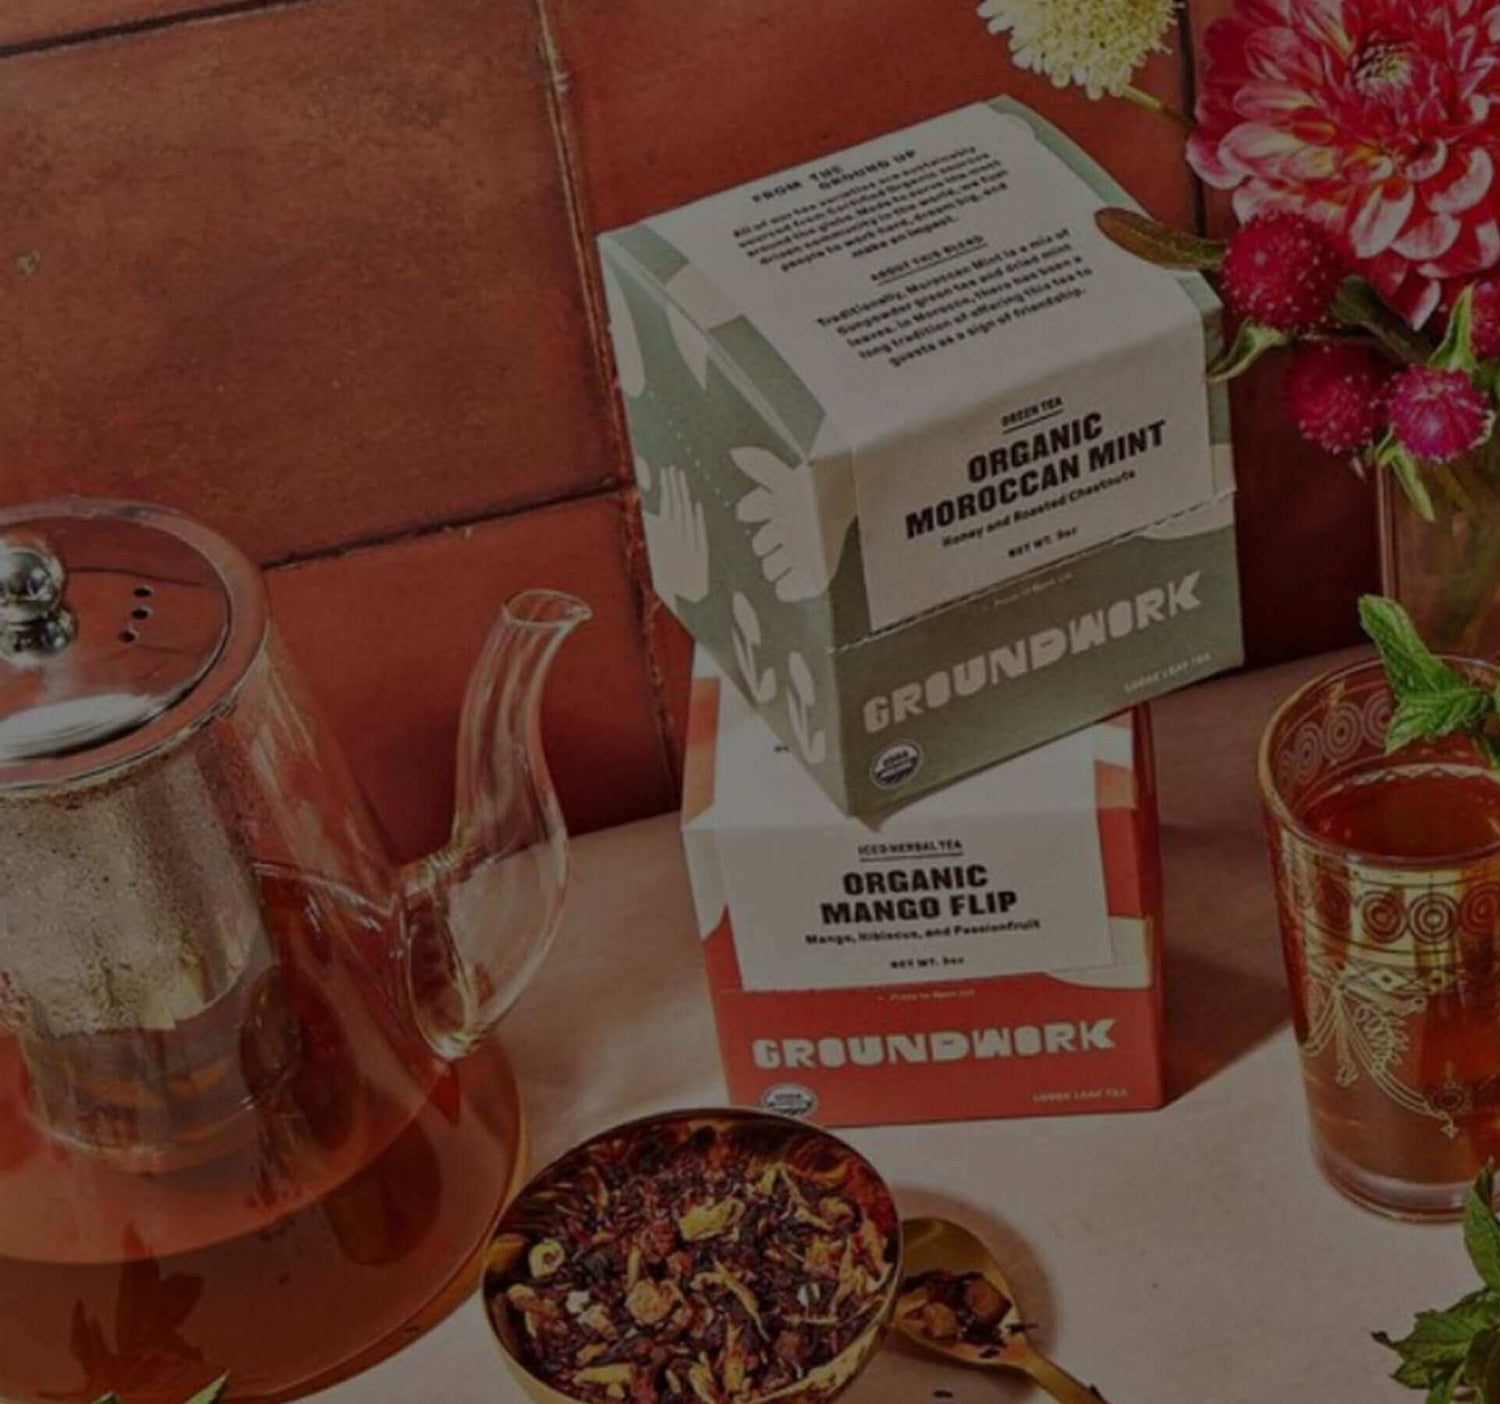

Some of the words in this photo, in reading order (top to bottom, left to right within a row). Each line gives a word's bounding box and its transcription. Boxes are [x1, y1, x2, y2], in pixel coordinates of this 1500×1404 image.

[733, 226, 753, 239] All
[753, 220, 768, 231] of
[769, 212, 793, 225] our
[792, 204, 818, 215] tea
[818, 181, 877, 207] varieties
[878, 173, 901, 185] are
[901, 146, 976, 177] sustainably
[751, 181, 802, 203] FROM
[809, 165, 843, 182] THE
[818, 160, 891, 190] GROUND
[892, 149, 916, 163] UP
[738, 223, 792, 249] sourced
[792, 212, 826, 228] from
[885, 171, 938, 194] Organic
[938, 152, 991, 175] sources
[746, 235, 793, 258] around
[792, 228, 818, 240] the
[855, 200, 892, 216] Made
[891, 194, 908, 203] to
[908, 181, 945, 198] serve
[944, 173, 968, 184] the
[759, 245, 802, 265] driven
[803, 218, 878, 249] community
[877, 212, 893, 222] in
[892, 203, 917, 216] the
[960, 180, 981, 191] we
[780, 250, 826, 273] people
[825, 243, 843, 254] to
[843, 230, 876, 248] work
[913, 202, 957, 222] dream
[982, 182, 1008, 196] and
[852, 240, 888, 258] make
[889, 233, 907, 245] an
[870, 260, 910, 282] ABOUT
[912, 250, 942, 265] THIS
[942, 235, 984, 255] BLEND
[905, 266, 972, 295] Moroccan
[971, 253, 1003, 270] Mint
[1002, 248, 1018, 258] is
[1019, 245, 1028, 253] a
[1029, 235, 1054, 249] mix
[1055, 228, 1070, 240] of
[836, 302, 912, 336] Gunpowder
[913, 288, 953, 309] green
[952, 279, 978, 292] tea
[979, 267, 1004, 284] and
[1005, 254, 1040, 273] dried
[1041, 243, 1072, 260] mint
[973, 281, 1013, 300] there
[1012, 271, 1039, 285] has
[1037, 259, 1072, 277] been
[1073, 255, 1083, 264] a
[858, 343, 893, 359] long
[890, 320, 953, 348] tradition
[953, 311, 968, 324] of
[970, 293, 1025, 318] offering
[1023, 282, 1052, 297] this
[1051, 274, 1076, 286] tea
[1075, 267, 1093, 278] to
[889, 343, 937, 368] guests
[938, 336, 955, 347] as
[955, 332, 966, 341] a
[966, 319, 996, 337] sign
[996, 311, 1012, 325] of
[1001, 405, 1040, 427] GREEN
[1040, 396, 1063, 411] TEA
[967, 412, 1103, 483] ORGANIC
[905, 453, 1080, 540] MOROCCAN
[1088, 419, 1165, 472] MINT
[942, 526, 984, 548] Honey
[986, 515, 1011, 533] and
[1013, 494, 1067, 523] Roasted
[1068, 469, 1136, 503] Chestnuts
[1007, 542, 1031, 558] NET
[864, 570, 1201, 733] GROUNDWORK
[857, 843, 888, 856] ICED
[887, 841, 937, 853] HERBAL
[938, 839, 963, 850] TEA
[843, 864, 988, 896] ORGANIC
[805, 934, 857, 946] Mango,
[858, 930, 923, 942] Hibiscus,
[924, 926, 951, 938] and
[953, 919, 1041, 935] Passionfruit
[820, 897, 941, 925] MANGO
[949, 890, 1017, 917] FLIP
[889, 959, 914, 969] NET
[752, 1018, 1115, 1069] GROUNDWORK
